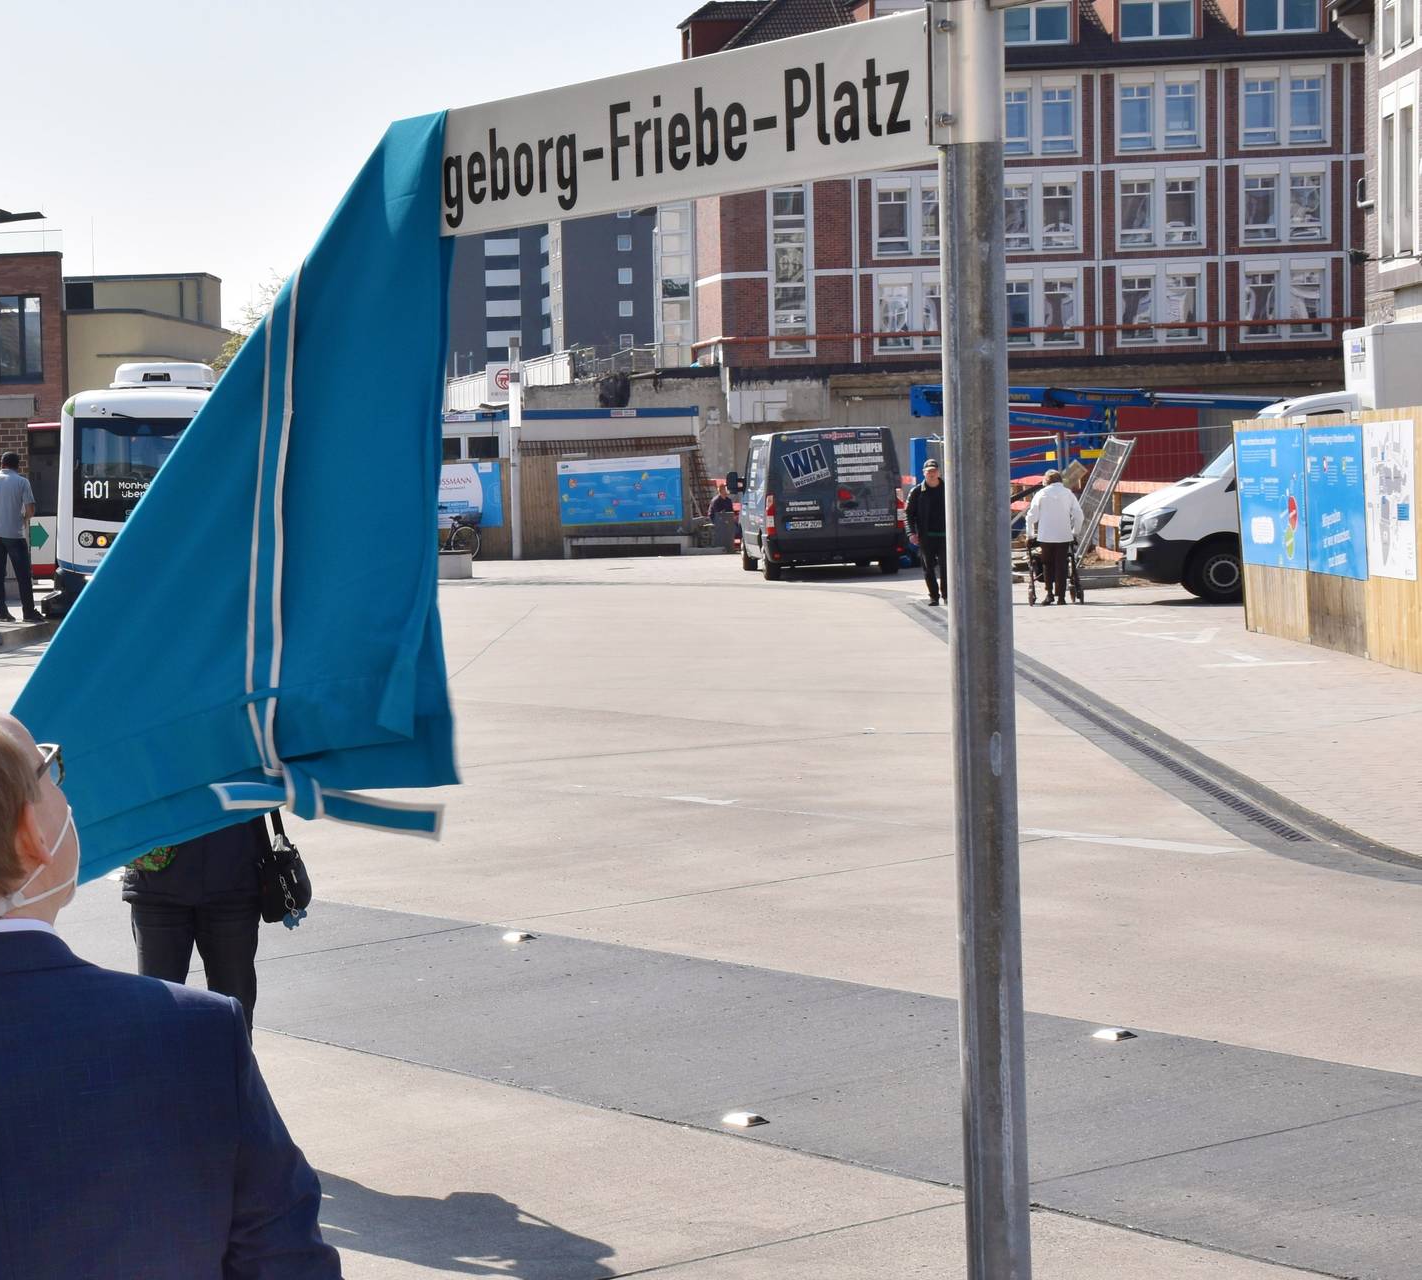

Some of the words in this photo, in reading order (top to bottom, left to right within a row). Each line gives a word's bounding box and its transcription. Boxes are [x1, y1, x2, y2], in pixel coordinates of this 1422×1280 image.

[443, 58, 911, 229] geborg-Friebe-Platz
[781, 444, 828, 480] WH
[84, 481, 109, 499] A01
[118, 481, 153, 490] Monhe
[441, 477, 472, 487] SSMANN
